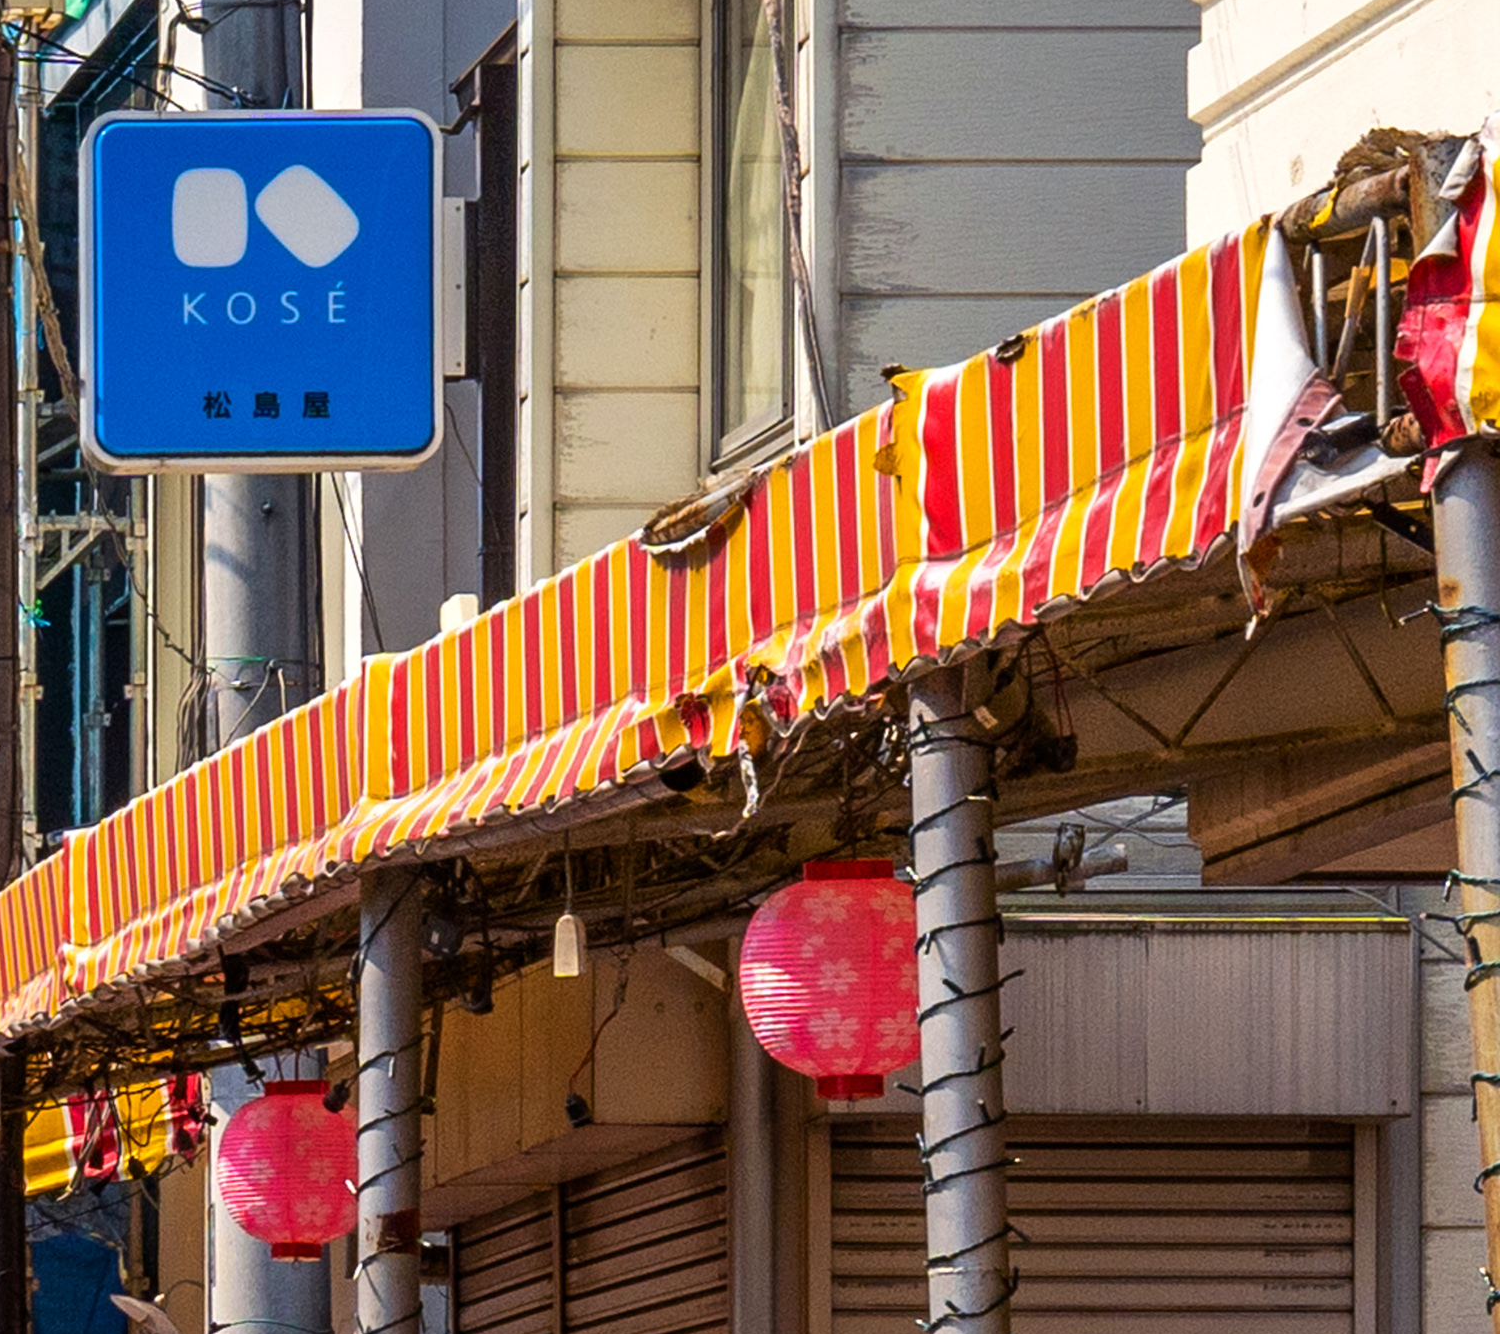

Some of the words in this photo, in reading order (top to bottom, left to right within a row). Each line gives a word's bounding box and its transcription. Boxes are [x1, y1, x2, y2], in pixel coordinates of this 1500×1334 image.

[182, 281, 347, 326] KOSÉ
[202, 390, 332, 420] 松島屋
